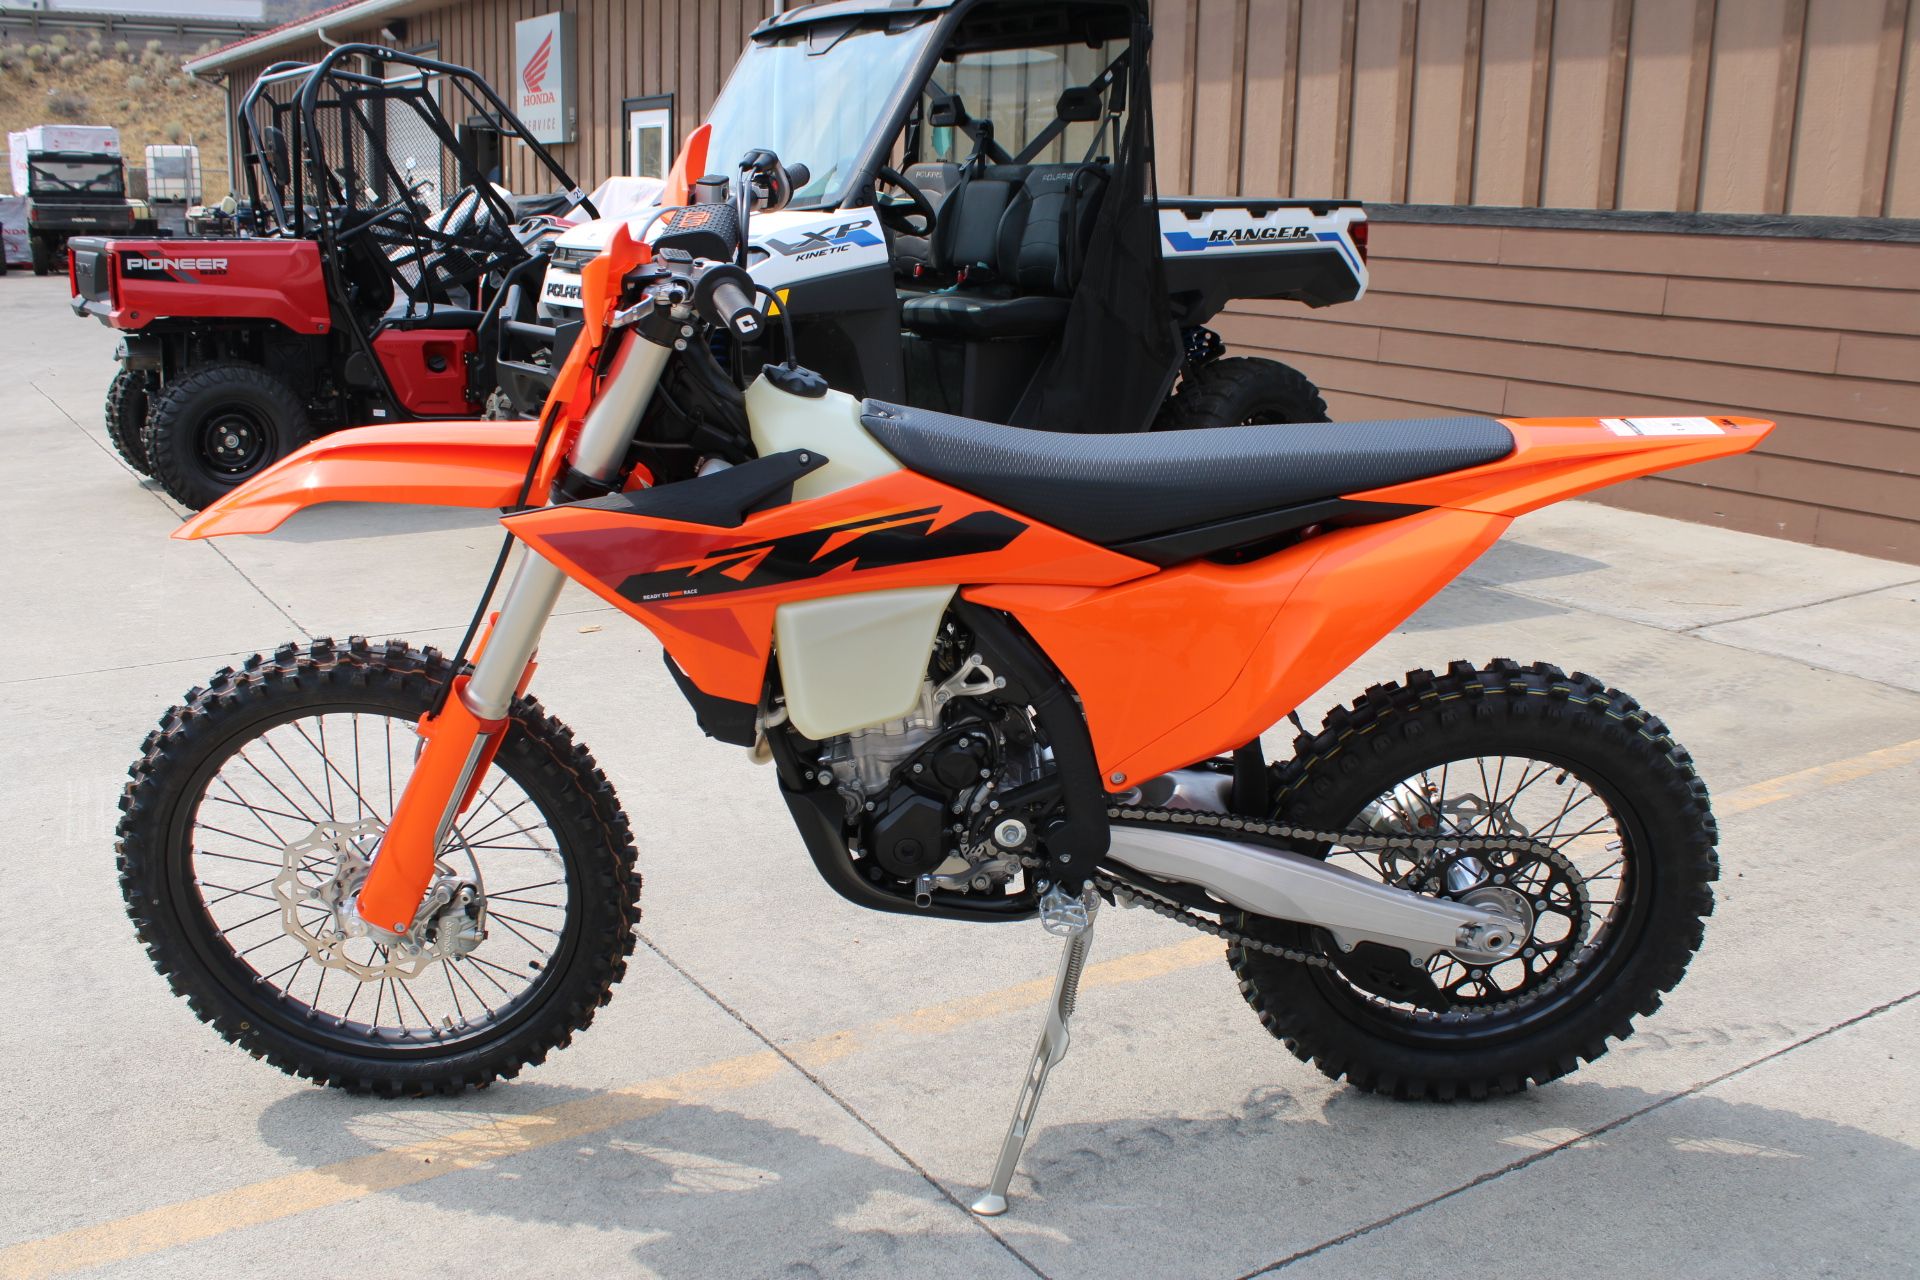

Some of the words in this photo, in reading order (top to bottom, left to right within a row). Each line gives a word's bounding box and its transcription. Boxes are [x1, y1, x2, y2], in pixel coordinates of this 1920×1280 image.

[523, 92, 555, 106] HONDA
[524, 117, 556, 131] SERVICE
[2, 228, 27, 236] NDA
[795, 219, 873, 249] XP
[1208, 226, 1310, 242] RANGER
[795, 244, 851, 262] KINETIC
[126, 257, 228, 271] PIONEER
[546, 282, 583, 300] POLAR
